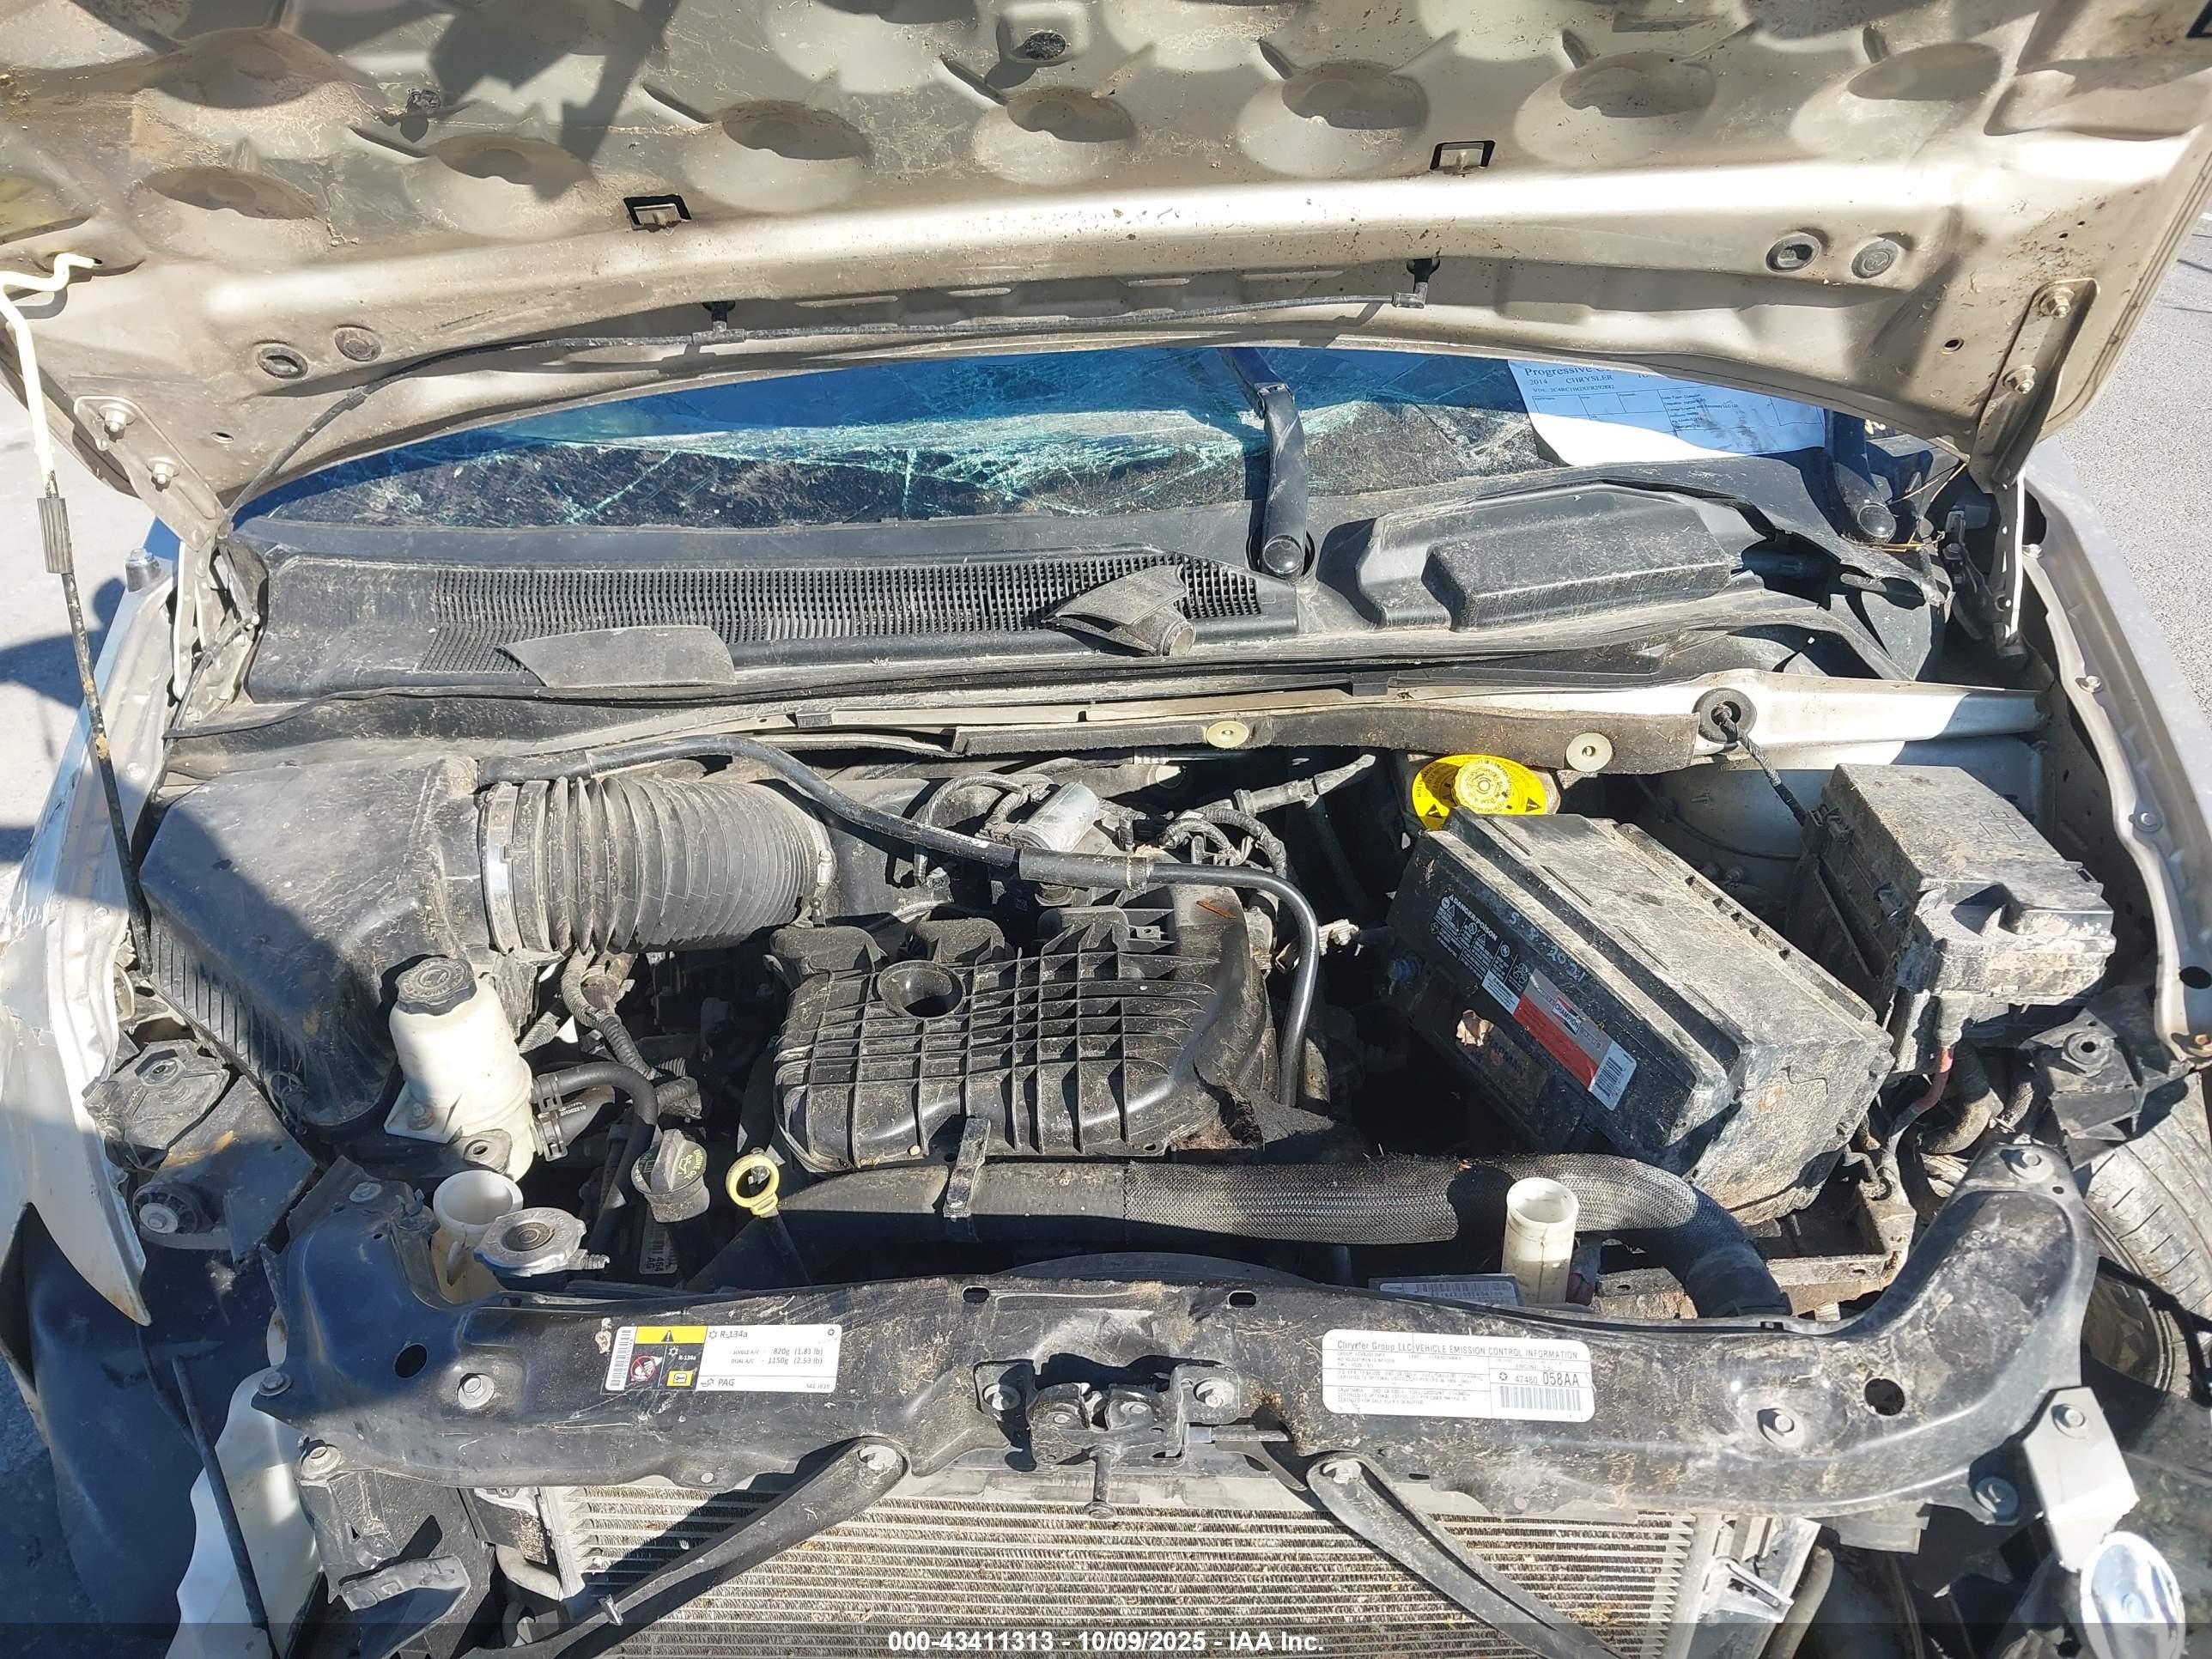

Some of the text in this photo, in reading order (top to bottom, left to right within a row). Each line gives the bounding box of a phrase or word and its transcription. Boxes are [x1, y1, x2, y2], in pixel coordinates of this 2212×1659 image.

[1565, 374, 1614, 384] CHRYSLER
[1554, 1001, 1582, 1033] CHAMPION
[720, 1330, 748, 1339] R-134a
[773, 1347, 791, 1357] 820g
[1371, 1341, 1395, 1352] Group
[1398, 1342, 1413, 1352] LLC
[1414, 1343, 1447, 1354] VEHICLE
[1449, 1345, 1486, 1356] EMISSION
[1488, 1347, 1523, 1358] CONTROL
[1525, 1349, 1578, 1360] INFORMATION
[768, 1357, 789, 1365] 1150g
[718, 1378, 735, 1387] PAG
[1542, 1371, 1580, 1387] 058AA
